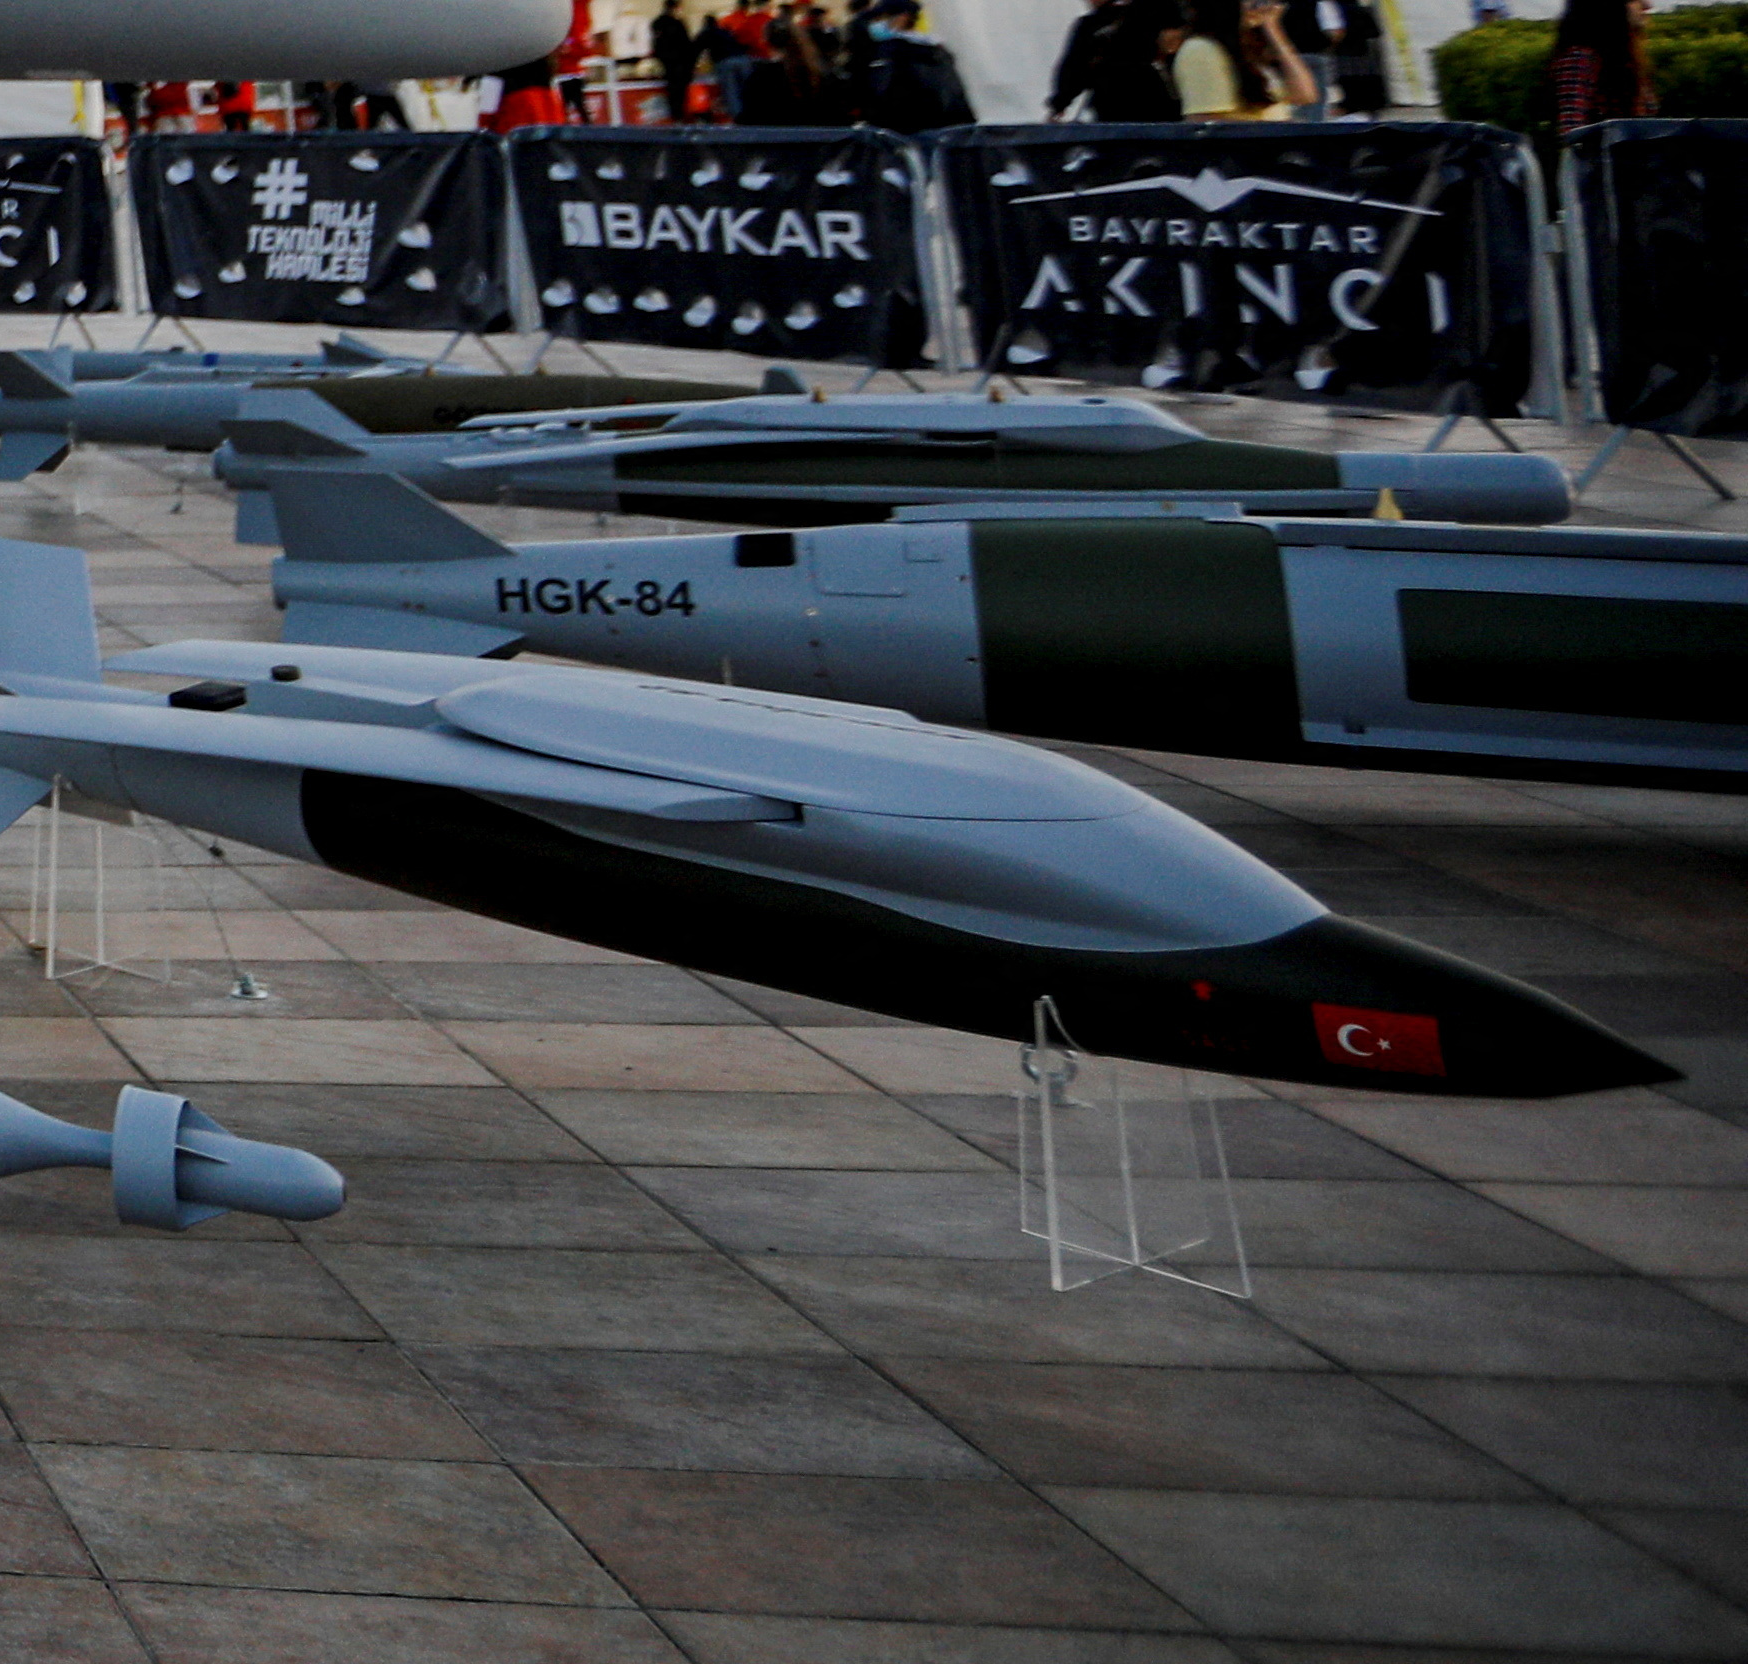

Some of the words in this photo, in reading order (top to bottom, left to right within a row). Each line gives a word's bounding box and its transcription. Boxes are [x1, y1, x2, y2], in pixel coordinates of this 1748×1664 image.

[602, 202, 872, 261] BAYKAR
[1067, 214, 1381, 254] BAYRAKTAR
[1019, 254, 1451, 334] AKINCI
[495, 577, 696, 618] HGK-84
